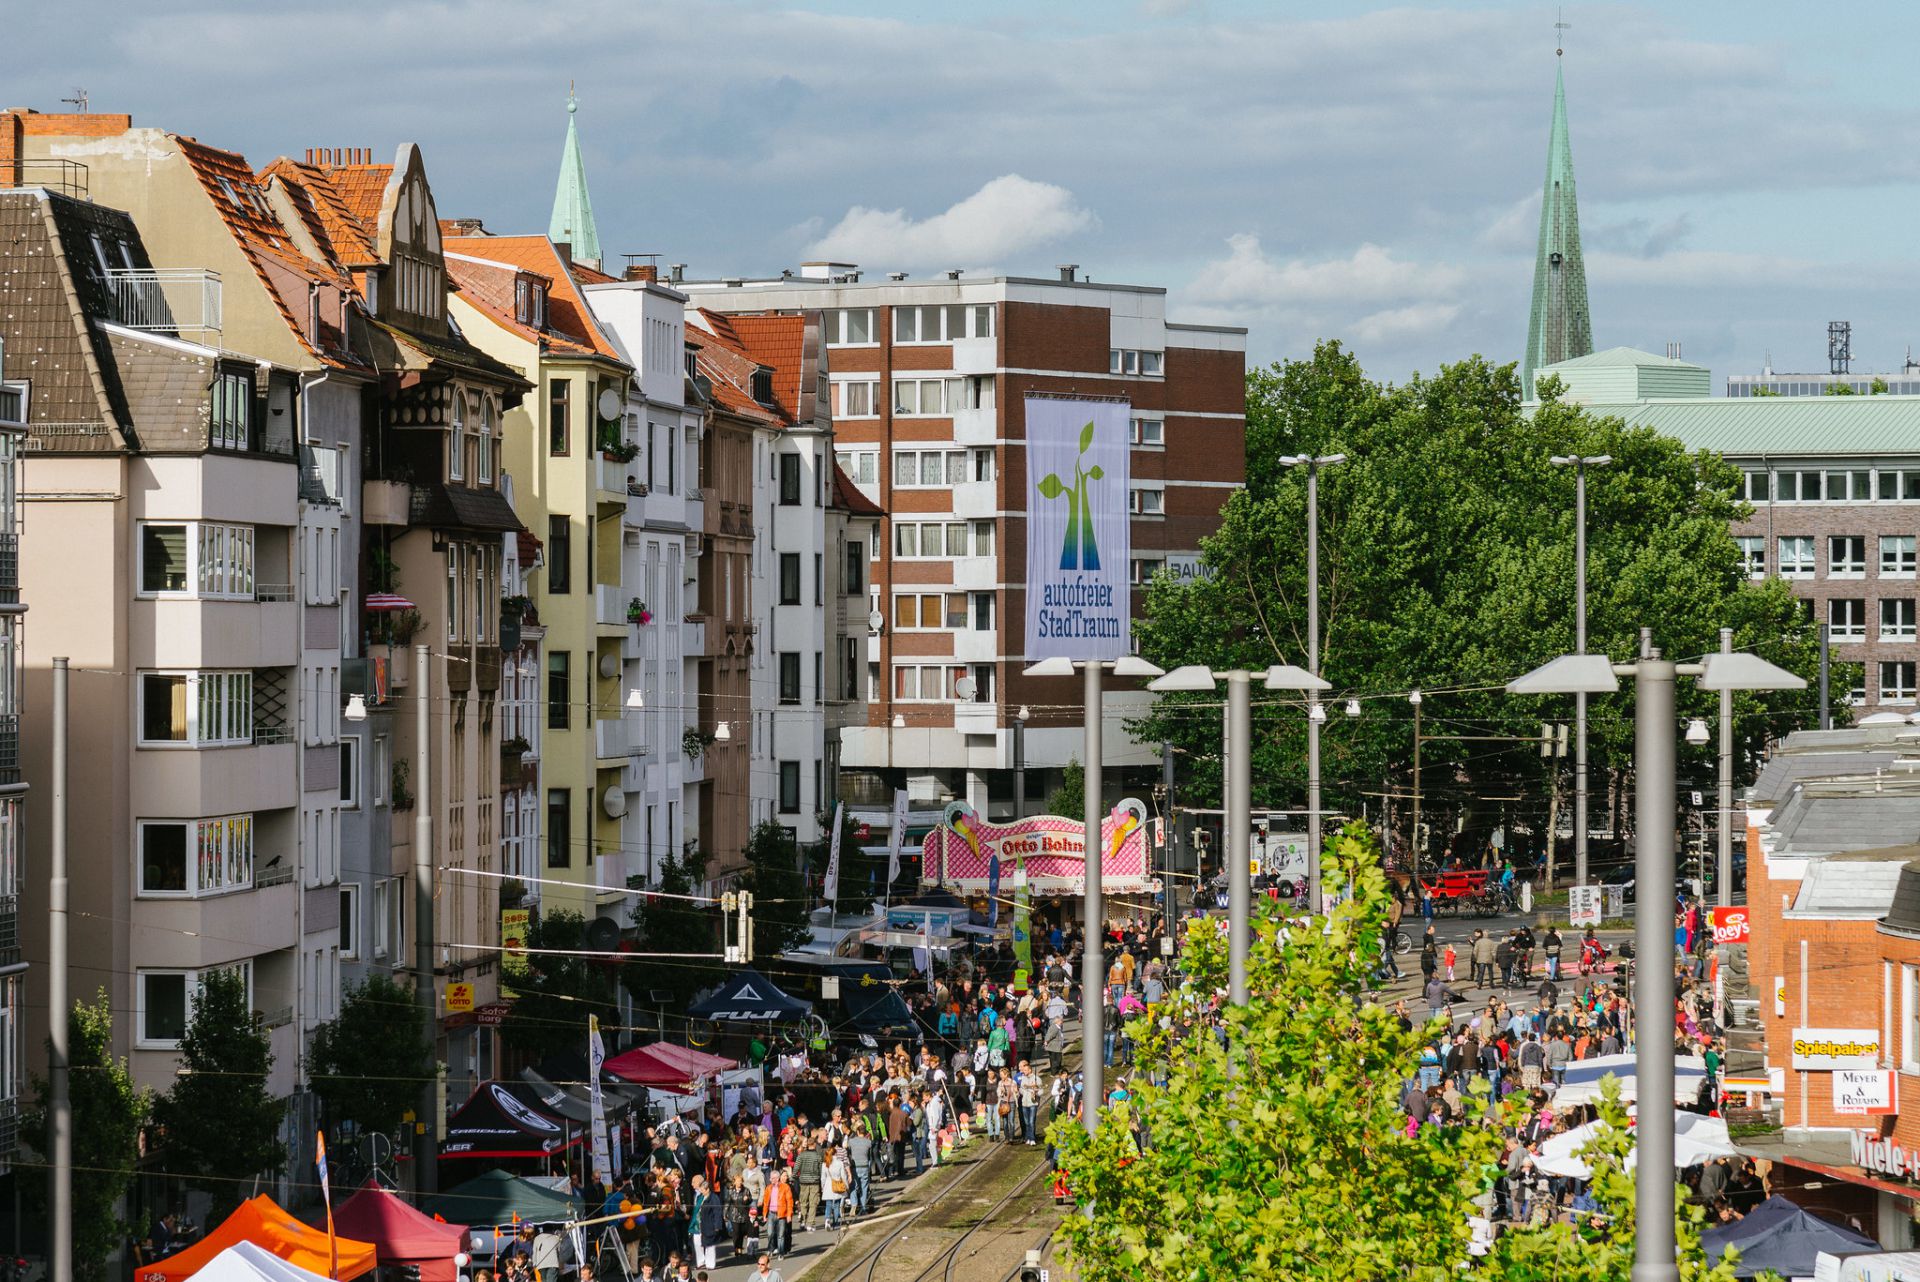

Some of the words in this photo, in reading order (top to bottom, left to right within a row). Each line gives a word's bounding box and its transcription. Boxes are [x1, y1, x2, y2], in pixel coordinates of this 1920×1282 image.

[1170, 562, 1214, 580] BAUM
[1044, 575, 1113, 608] autofreier
[1038, 609, 1120, 638] StadTraum
[1002, 838, 1039, 856] Otto
[1042, 836, 1086, 853] Bohn
[1713, 921, 1750, 940] Joey's
[478, 1015, 502, 1024] Barg
[481, 1006, 507, 1016] Sofor
[708, 1010, 783, 1021] FUJI
[1794, 1040, 1879, 1058] Spielpalast
[1856, 1087, 1865, 1097] &
